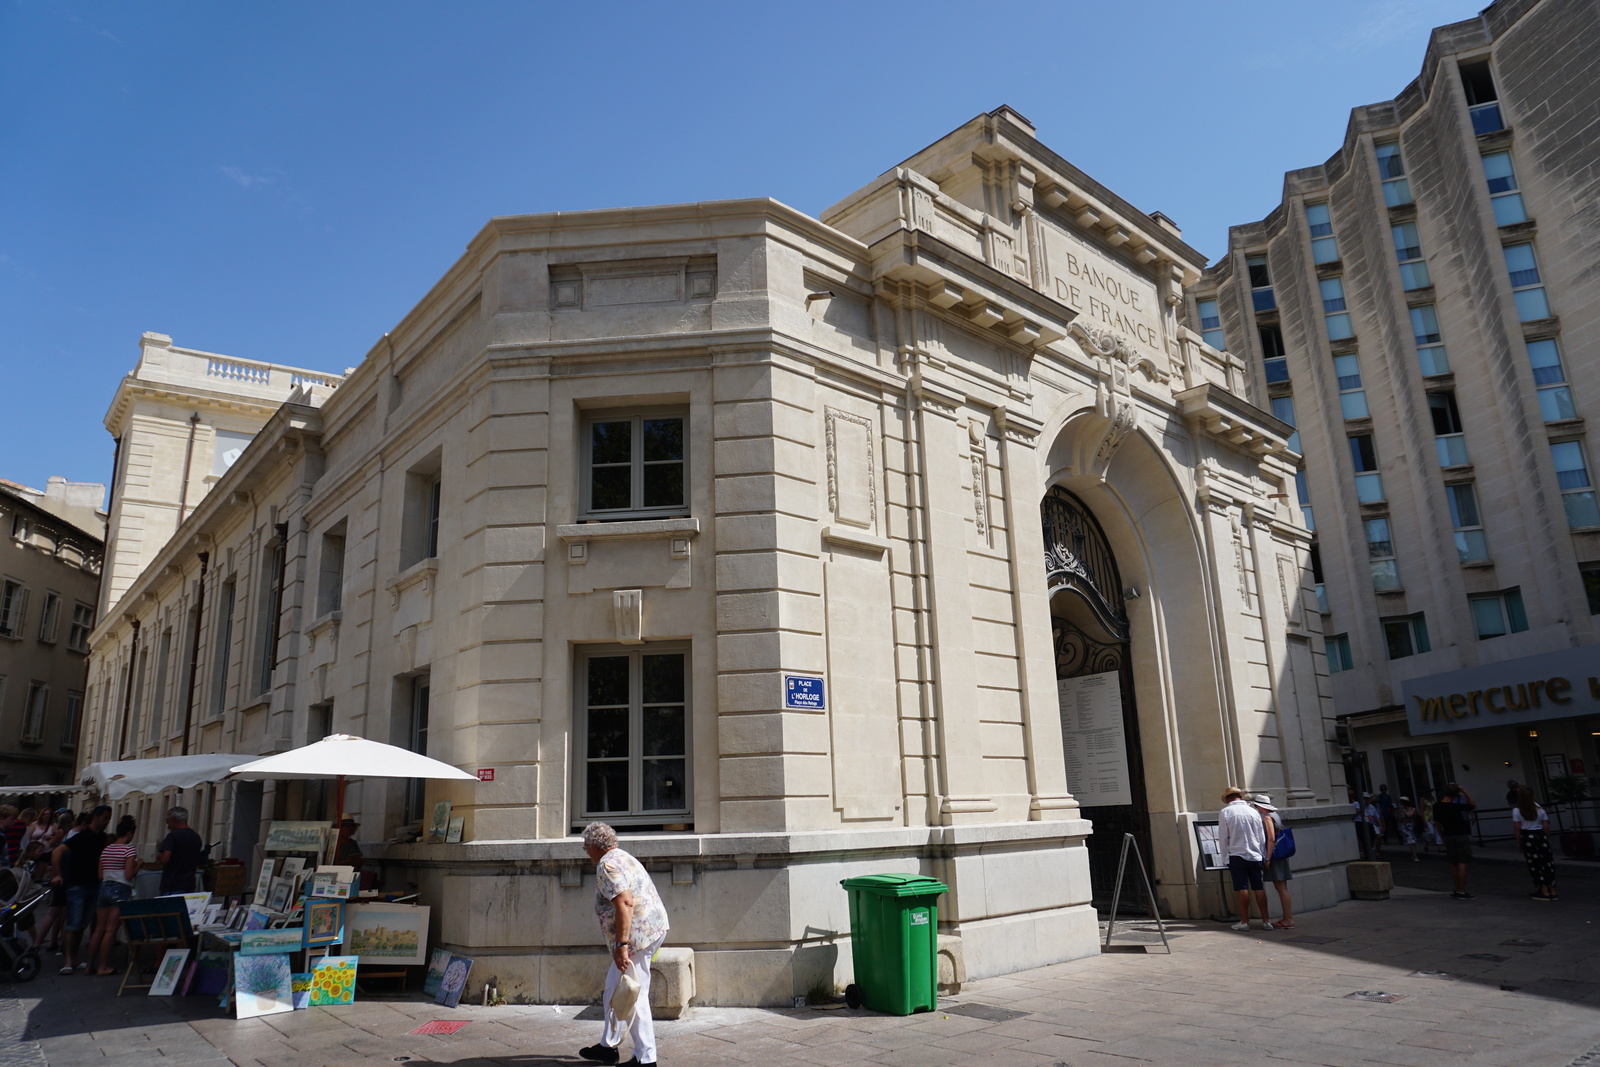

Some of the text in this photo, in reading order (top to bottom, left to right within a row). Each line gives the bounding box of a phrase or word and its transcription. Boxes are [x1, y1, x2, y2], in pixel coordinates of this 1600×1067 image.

[1055, 276, 1159, 350] DE FRANCE
[1066, 252, 1142, 313] BANQUE
[791, 693, 819, 701] L'HORLOGE
